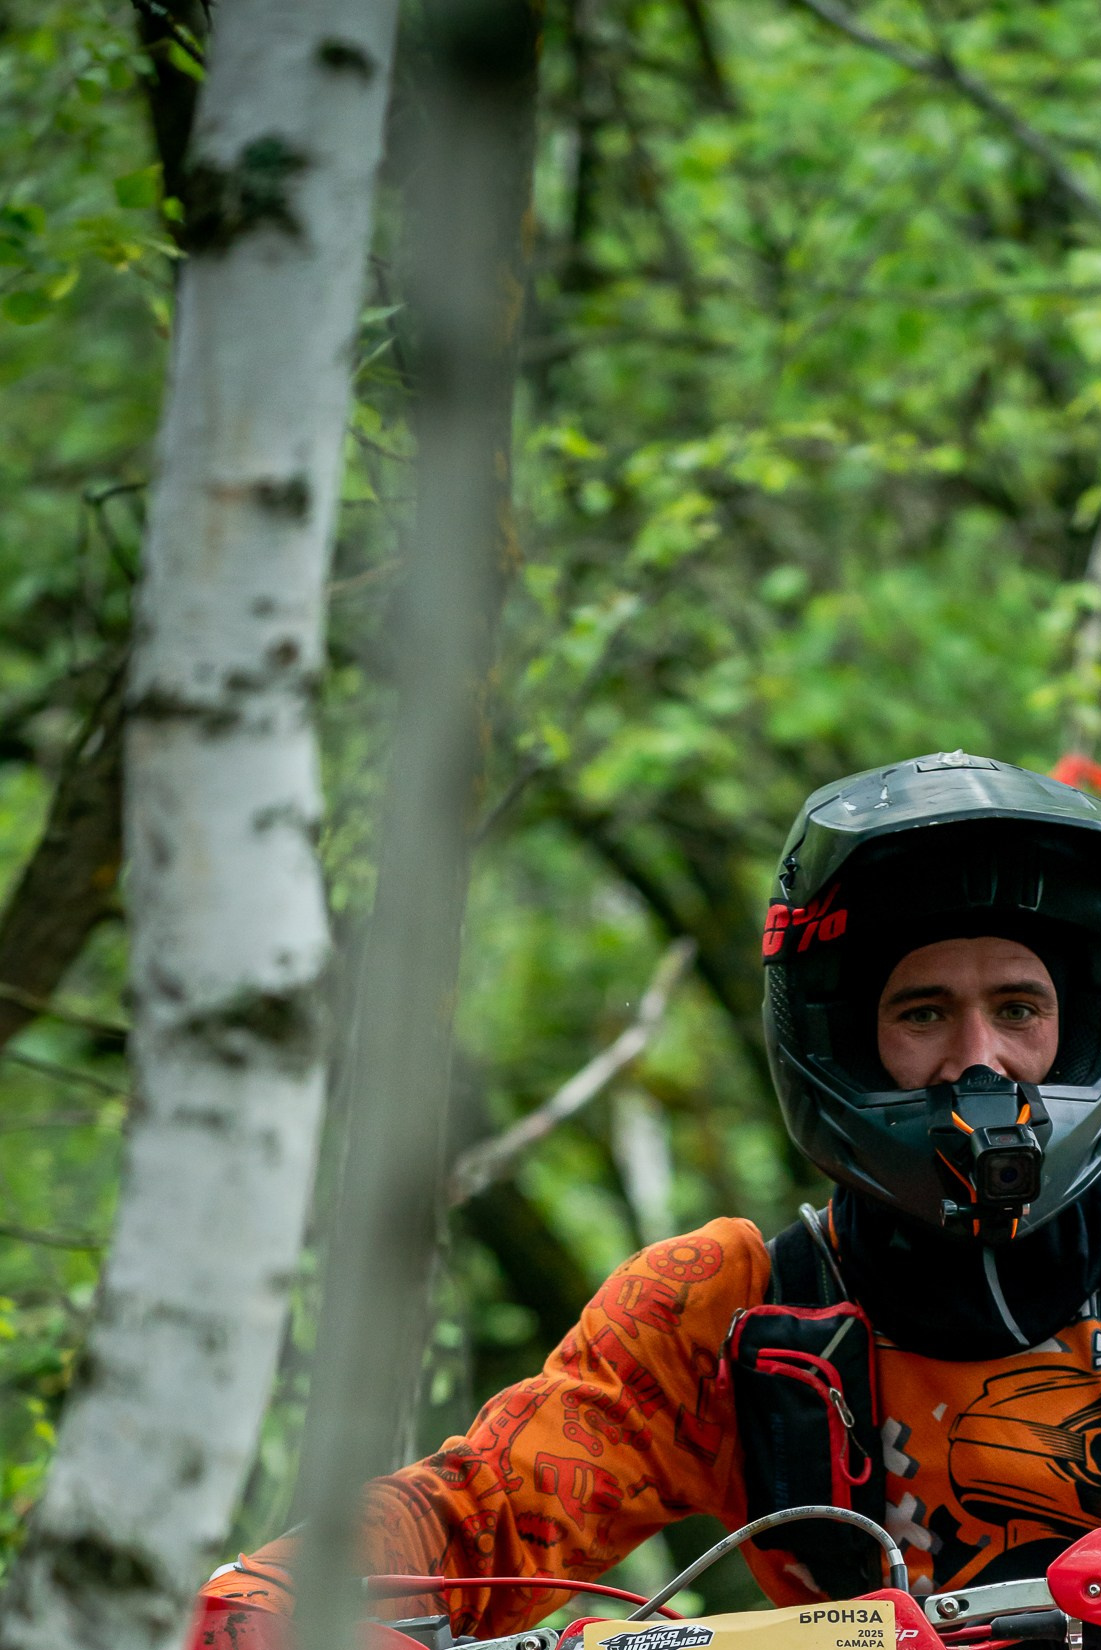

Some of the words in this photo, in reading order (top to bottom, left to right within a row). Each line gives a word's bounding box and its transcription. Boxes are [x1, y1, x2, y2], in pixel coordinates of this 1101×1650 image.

[799, 1609, 883, 1624] БРОНЗА
[626, 1630, 679, 1645] ТОЧКА
[858, 1629, 884, 1638] 2025
[836, 1639, 885, 1648] САМАРА
